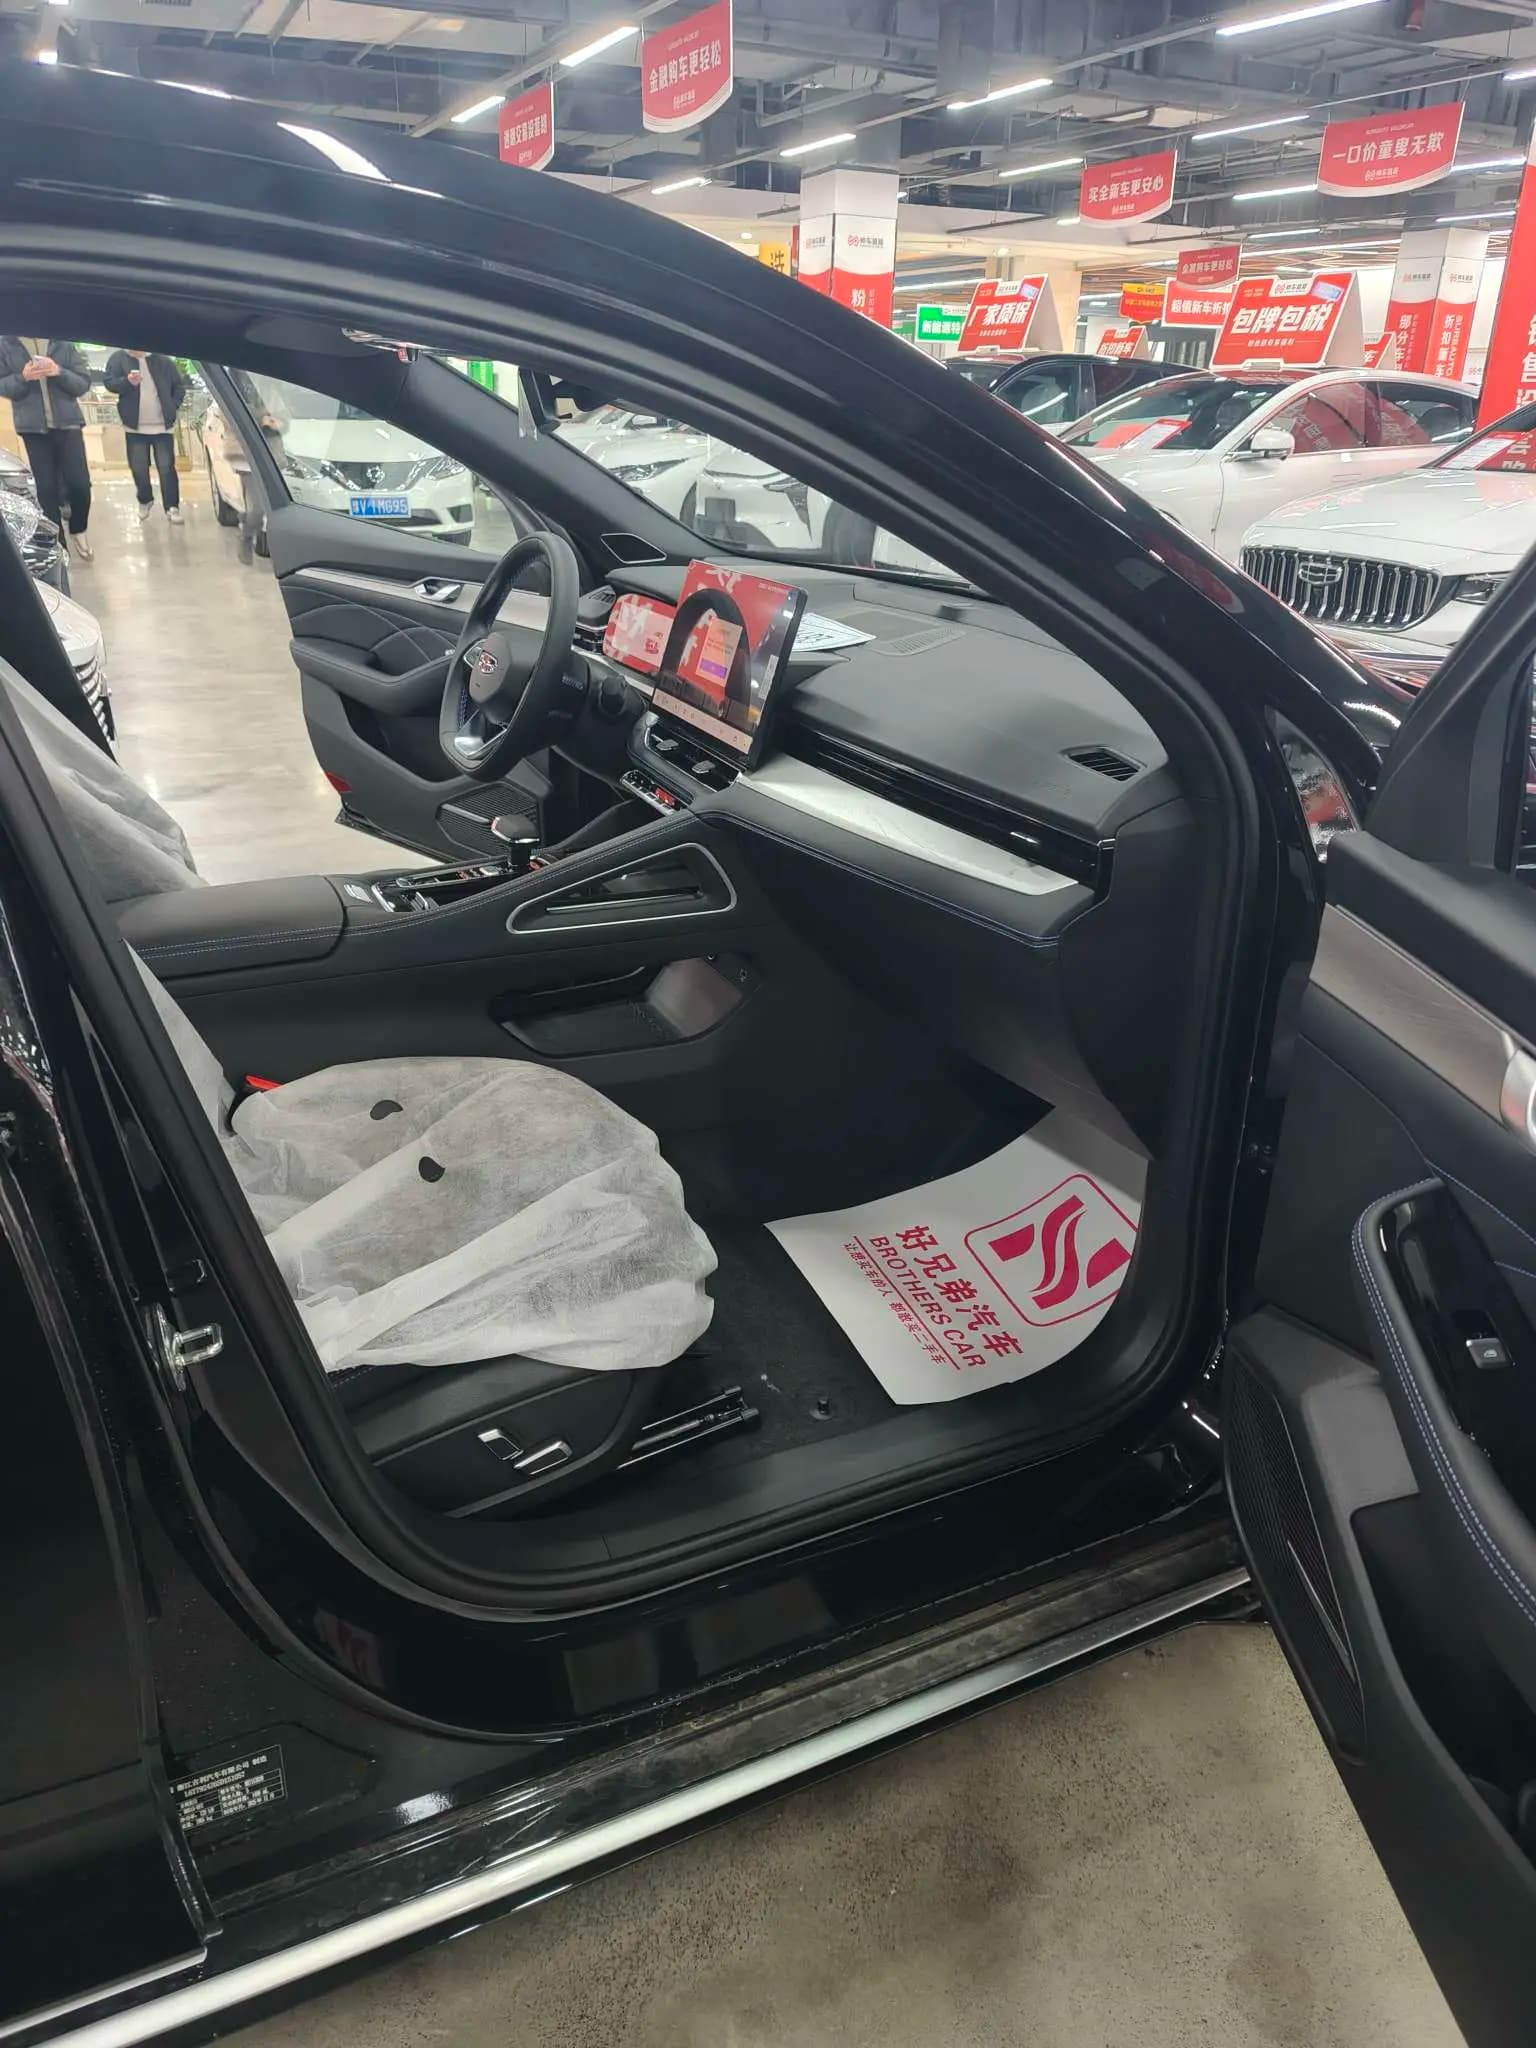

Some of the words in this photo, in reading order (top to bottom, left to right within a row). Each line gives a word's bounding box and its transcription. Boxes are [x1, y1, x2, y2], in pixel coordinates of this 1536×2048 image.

[649, 39, 721, 94] 金融购车更轻松
[1332, 131, 1445, 164] 一口价童叟无欺
[1088, 174, 1164, 204] 买全新车更安心
[967, 301, 1033, 328] 厂家质保
[1230, 302, 1335, 335] 包牌包税
[869, 1236, 952, 1325] BROTHERS
[943, 1329, 986, 1367] CAR
[896, 1226, 1024, 1357] 好兄弟汽车
